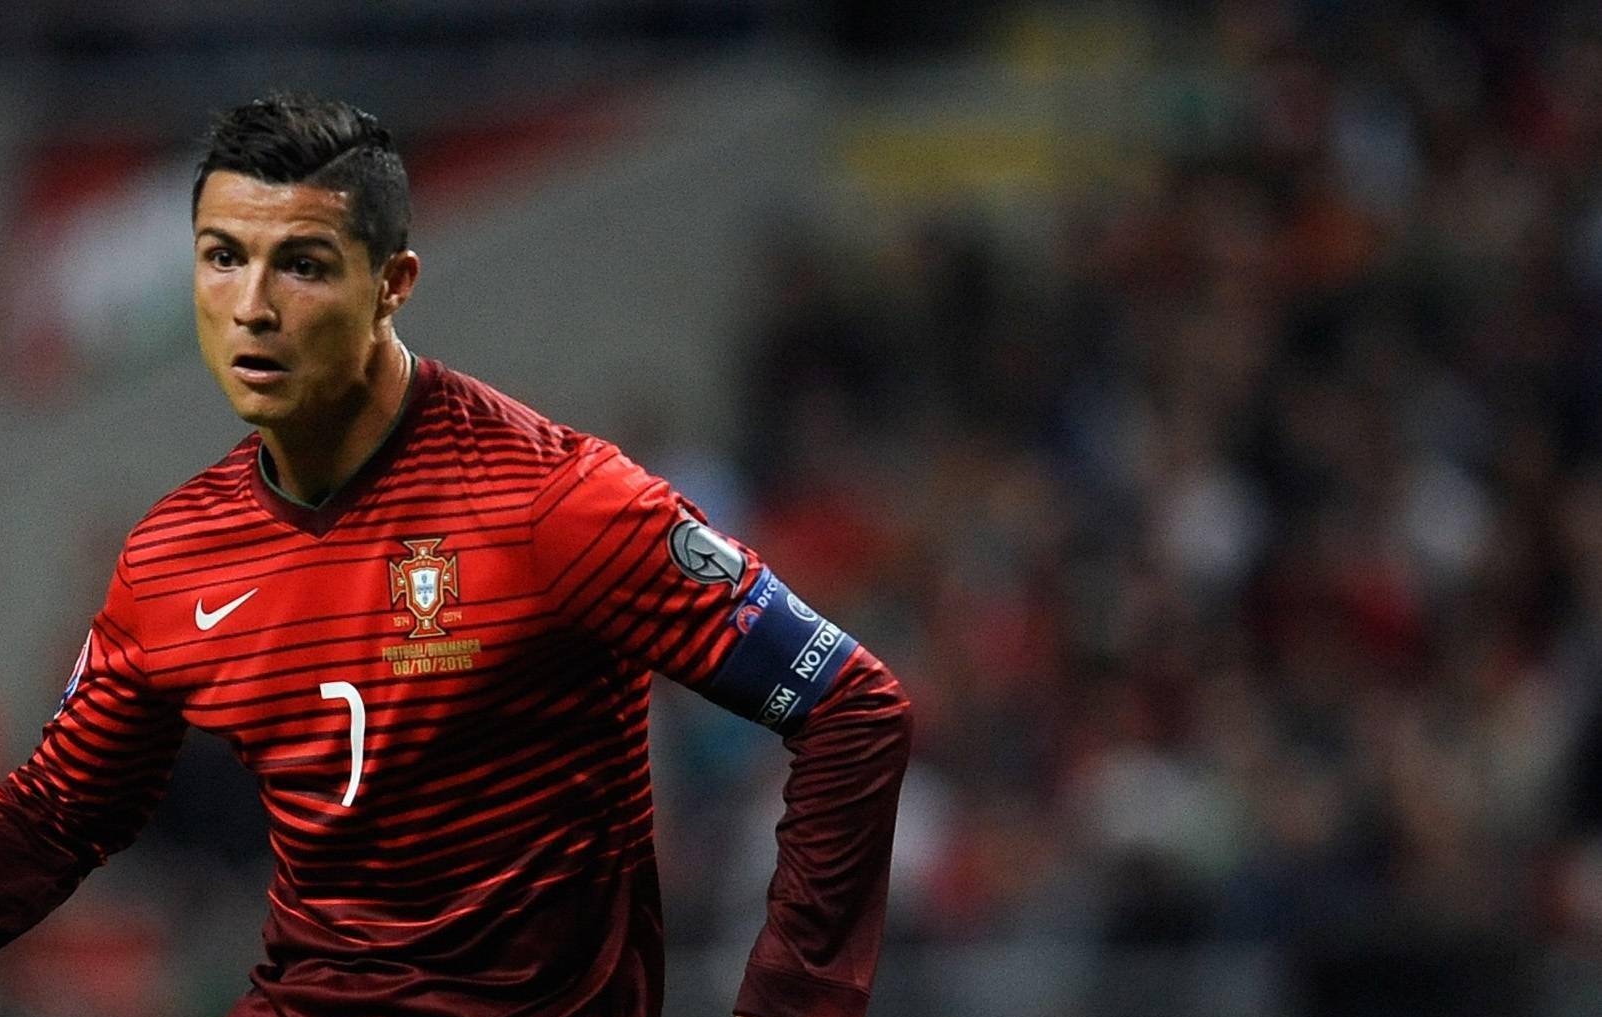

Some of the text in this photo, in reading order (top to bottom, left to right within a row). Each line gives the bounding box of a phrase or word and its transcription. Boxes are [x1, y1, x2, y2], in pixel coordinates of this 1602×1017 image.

[393, 655, 473, 676] 08/10/2015
[795, 650, 821, 679] NO
[761, 687, 796, 725] CISM
[320, 681, 366, 807] 7
